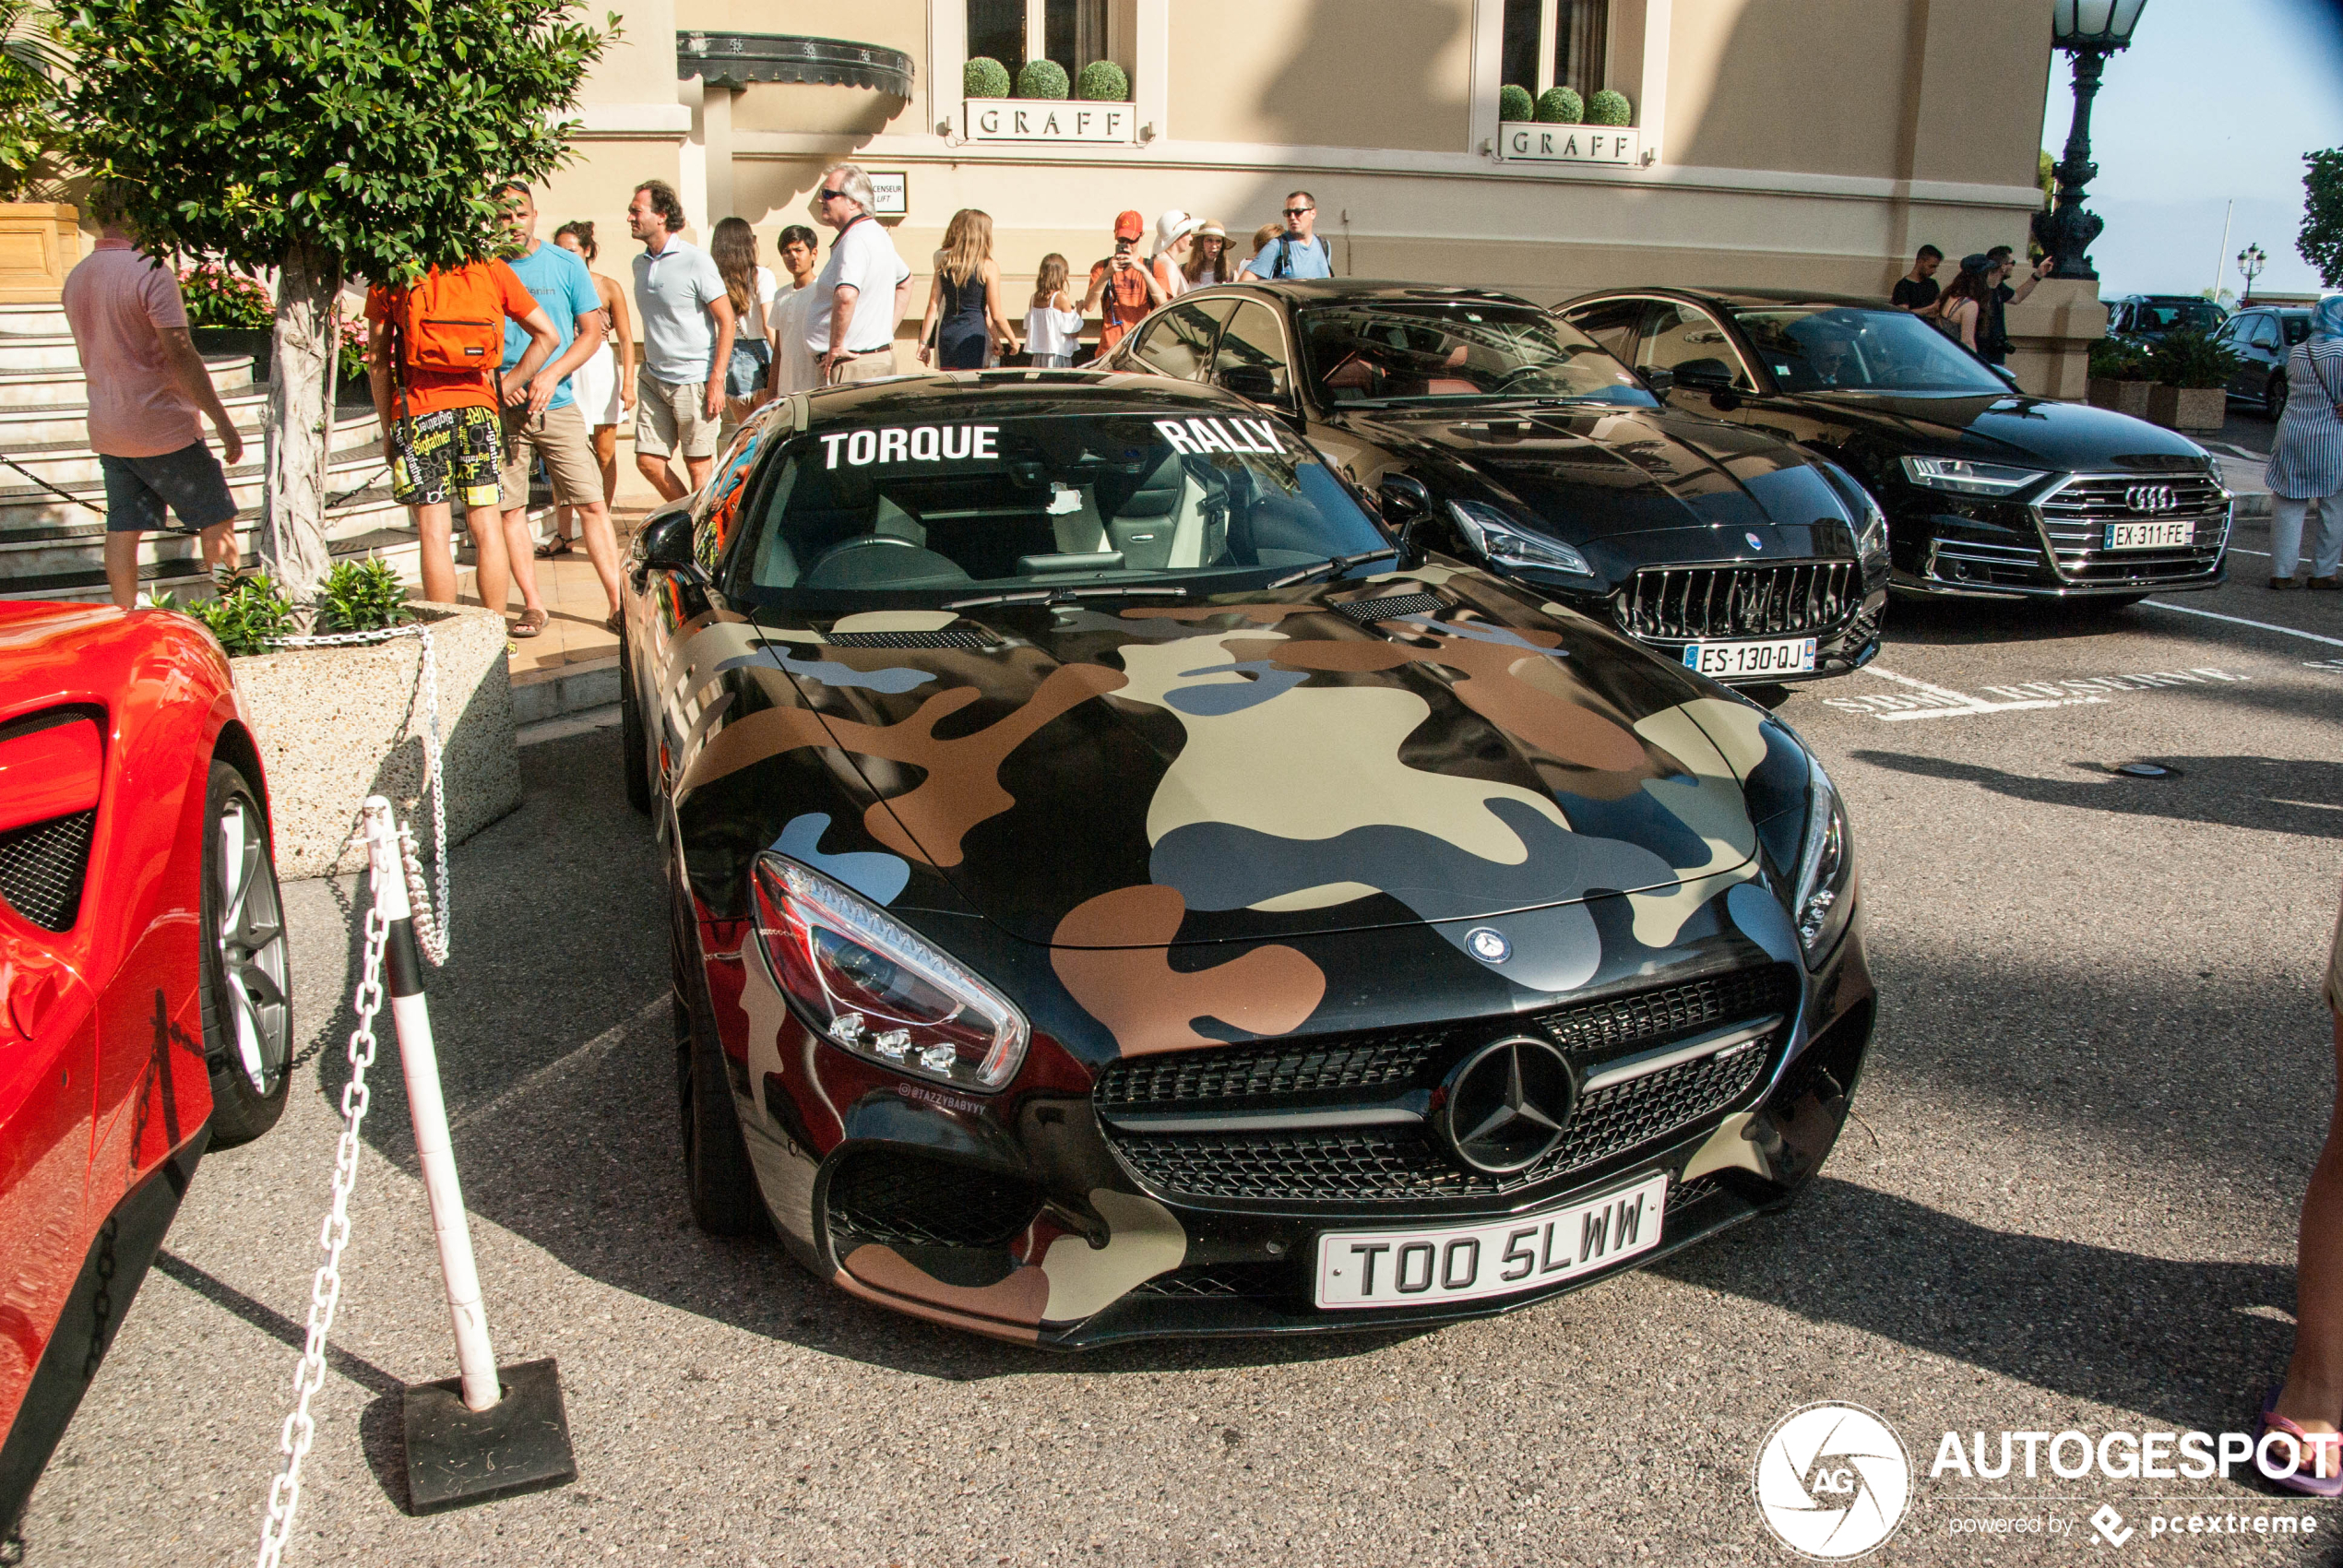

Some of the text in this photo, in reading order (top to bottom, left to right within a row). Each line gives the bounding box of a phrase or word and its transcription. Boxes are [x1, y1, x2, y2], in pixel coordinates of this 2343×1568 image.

[980, 110, 1121, 136] GRAFF
[1513, 131, 1628, 158] GRAFF
[872, 184, 902, 193] CENSEUR
[527, 286, 555, 295] enim
[412, 430, 451, 457] Bigfather
[820, 418, 1287, 469] TORQUE RALLY
[2116, 524, 2183, 545] EX-311-FE
[1701, 645, 1814, 672] ES-130-QJ 06
[1500, 1192, 1645, 1282] 5LWW
